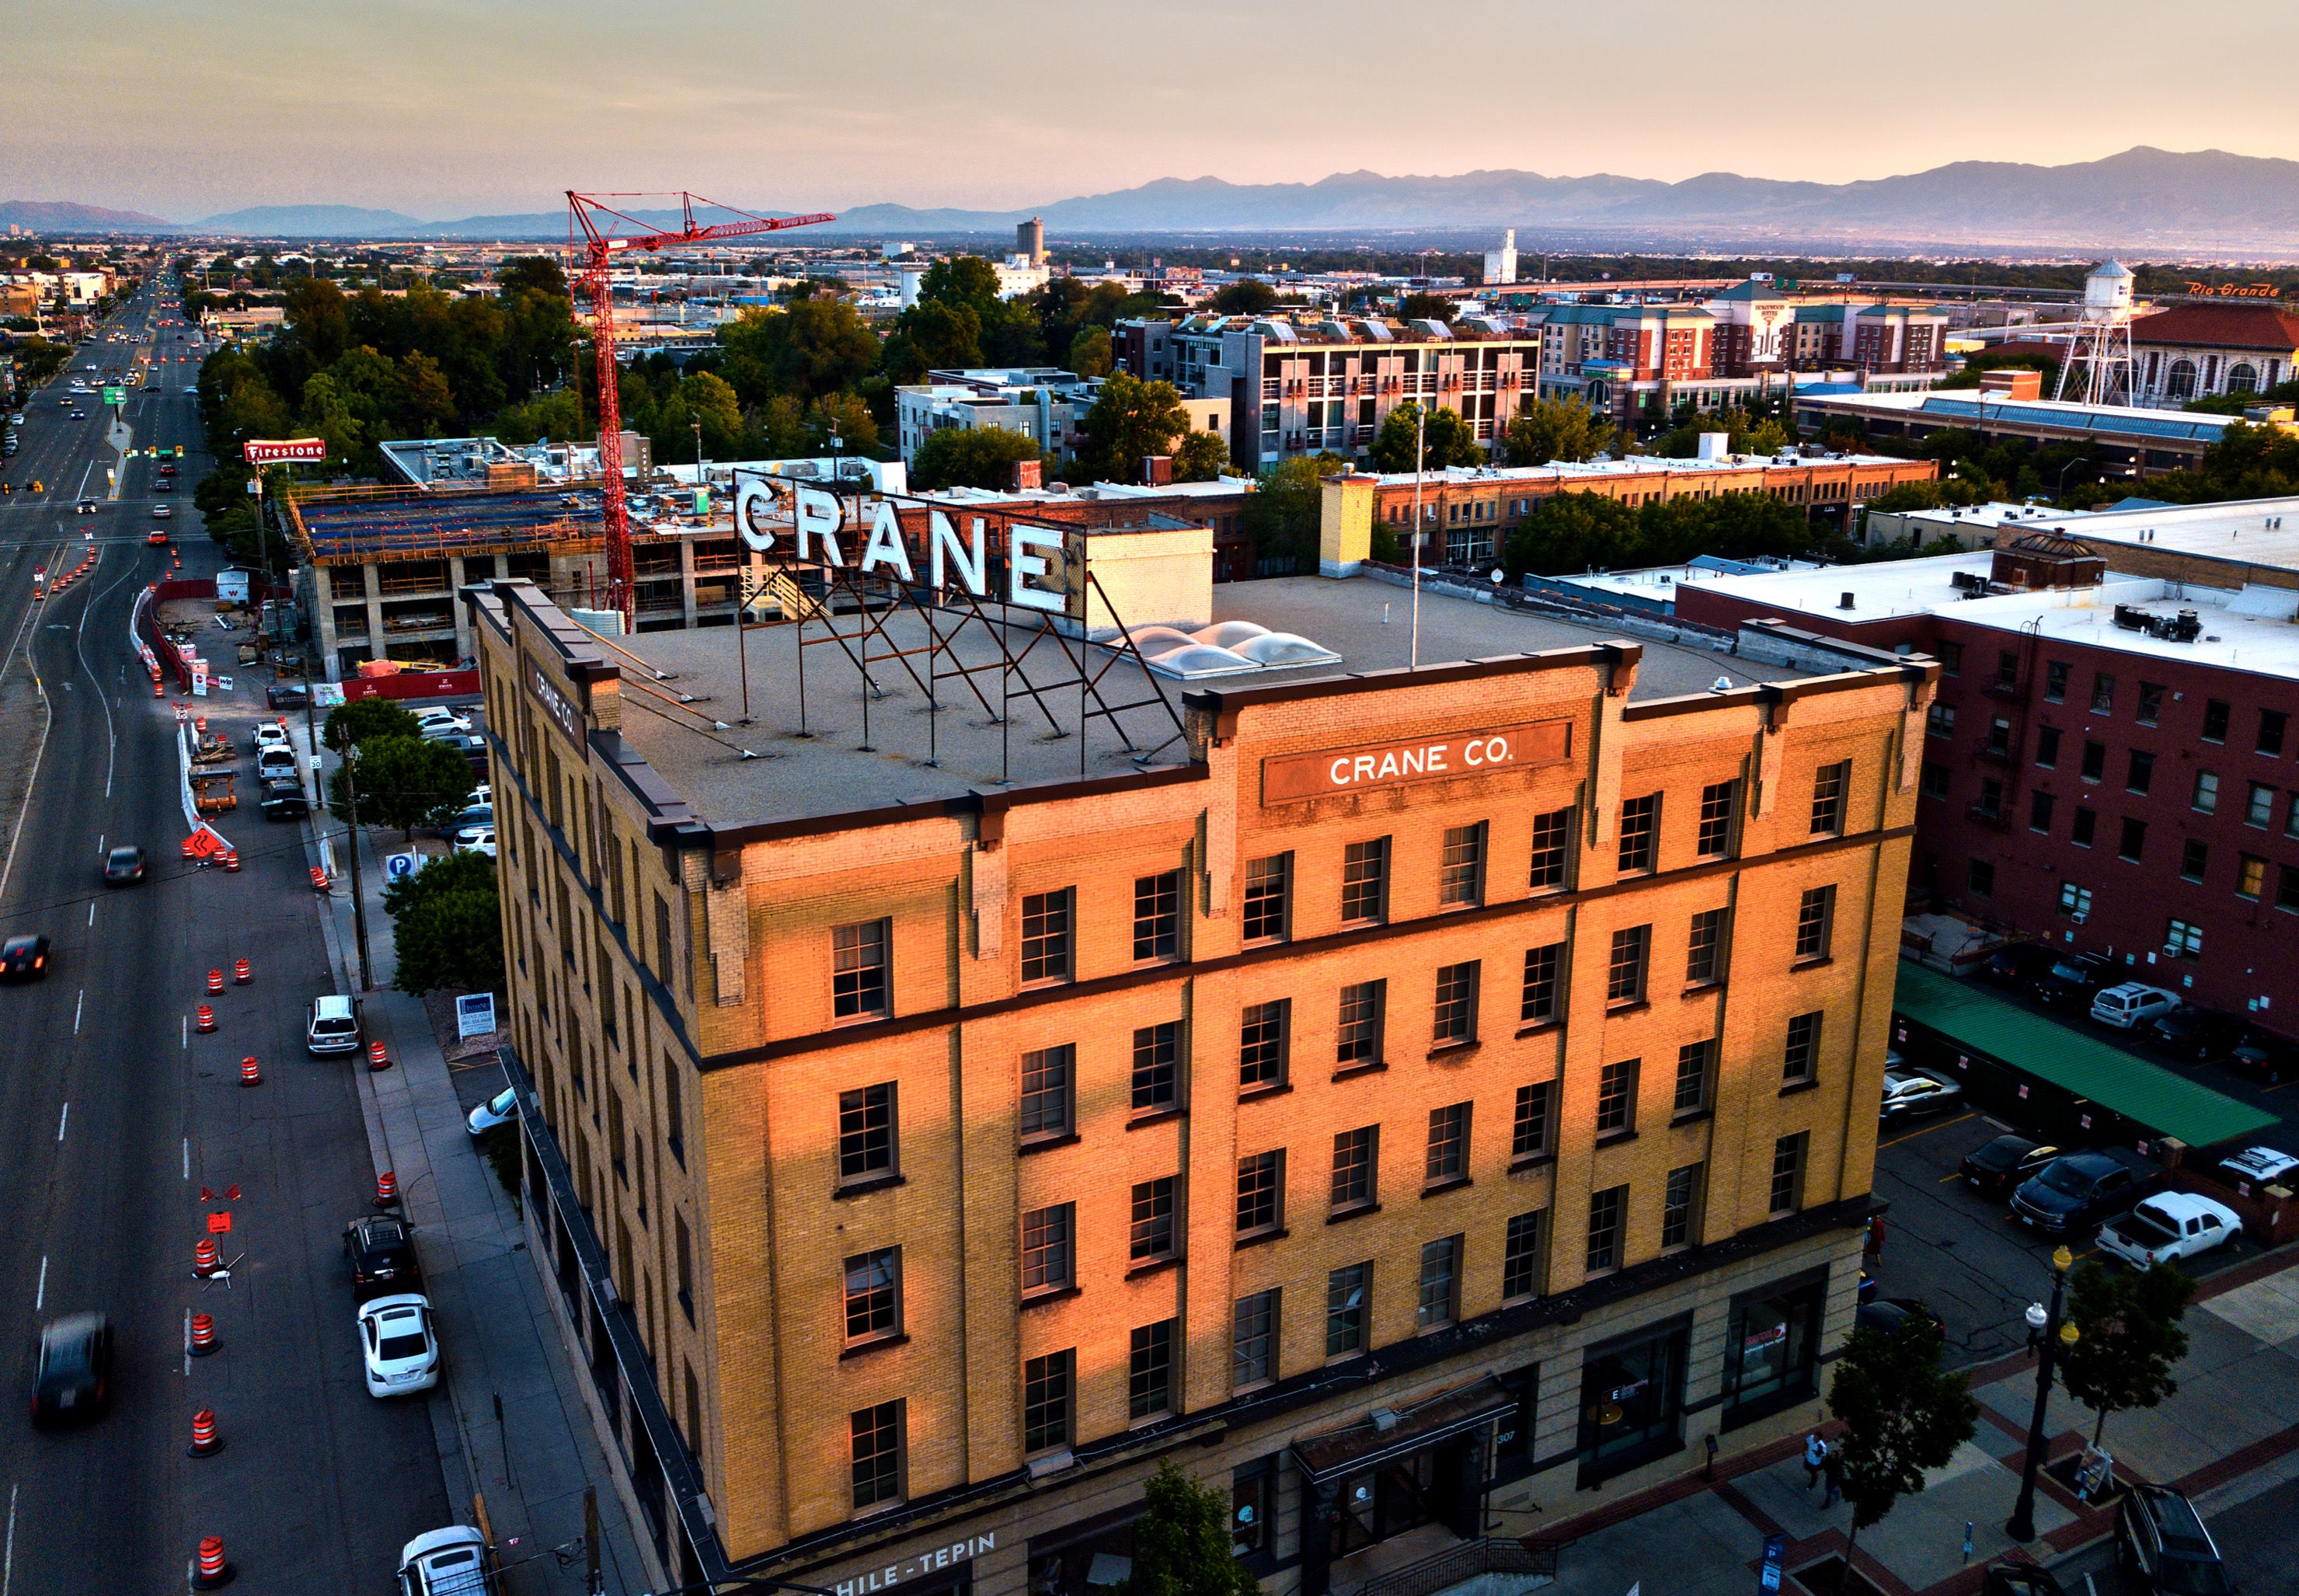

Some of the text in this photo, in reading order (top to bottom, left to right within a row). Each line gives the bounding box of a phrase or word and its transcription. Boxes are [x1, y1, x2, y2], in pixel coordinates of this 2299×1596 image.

[2184, 281, 2280, 297] Rio Grande
[247, 445, 323, 459] Firestone
[736, 479, 1070, 612] CRANE
[536, 671, 575, 736] CRANE CO.
[1329, 737, 1514, 785] CRANE CO.
[395, 858, 406, 874] P
[1497, 1430, 1516, 1444] 307
